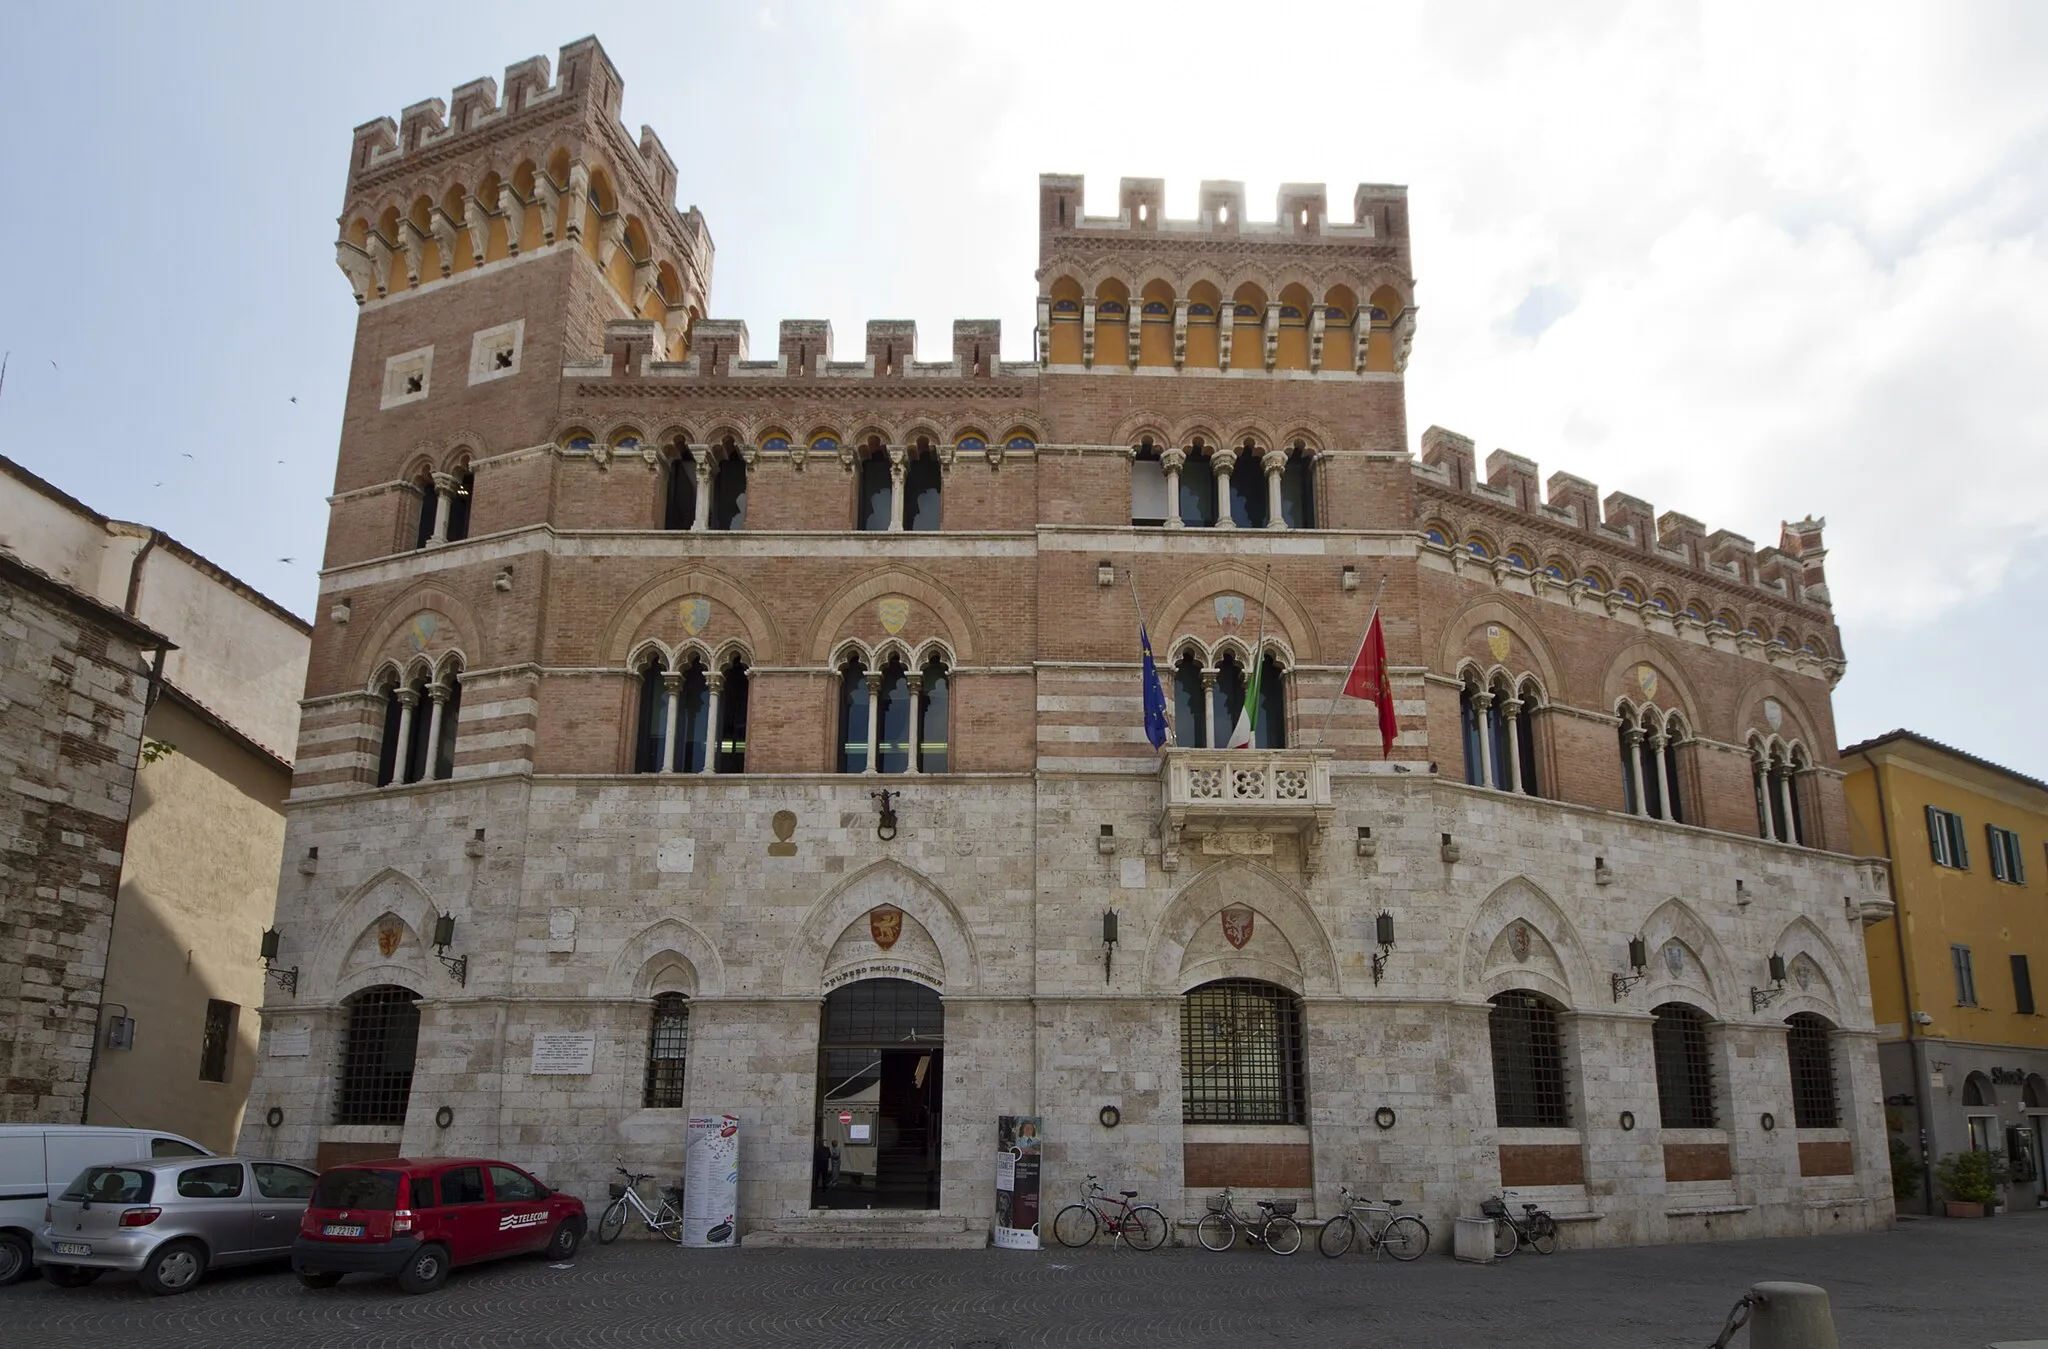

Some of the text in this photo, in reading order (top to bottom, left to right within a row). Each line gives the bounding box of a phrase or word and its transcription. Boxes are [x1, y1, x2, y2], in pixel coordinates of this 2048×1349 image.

[823, 965, 943, 987] PALAZZO DELLA PROVINCIA
[518, 1211, 549, 1223] TELECOM
